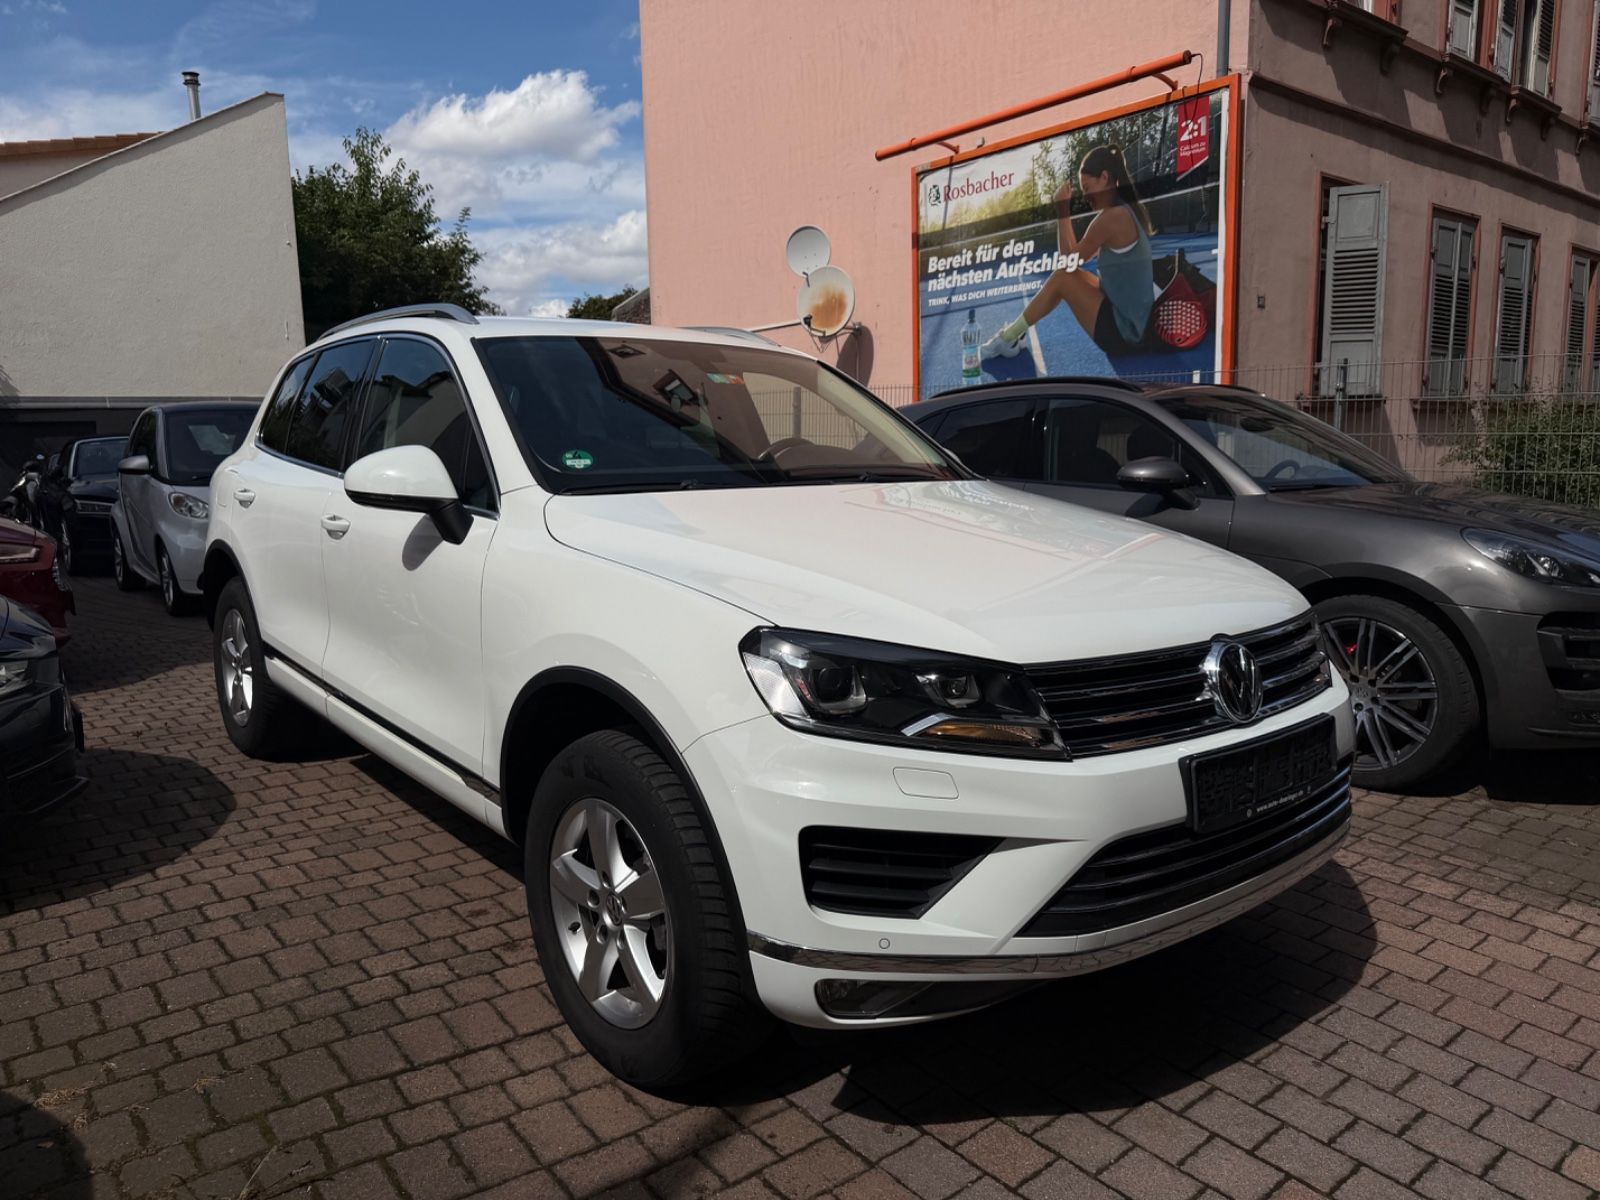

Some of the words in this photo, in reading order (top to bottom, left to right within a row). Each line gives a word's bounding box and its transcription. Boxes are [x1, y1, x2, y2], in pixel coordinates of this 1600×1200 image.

[943, 171, 1015, 202] Rosbacher
[928, 248, 973, 273] Bereit
[975, 244, 1000, 264] für
[1002, 239, 1035, 258] den
[928, 270, 993, 292] nächsten
[995, 251, 1085, 280] Aufschlag.
[928, 298, 950, 307] TRINK,
[951, 294, 968, 303] WAS
[968, 290, 986, 300] DICH
